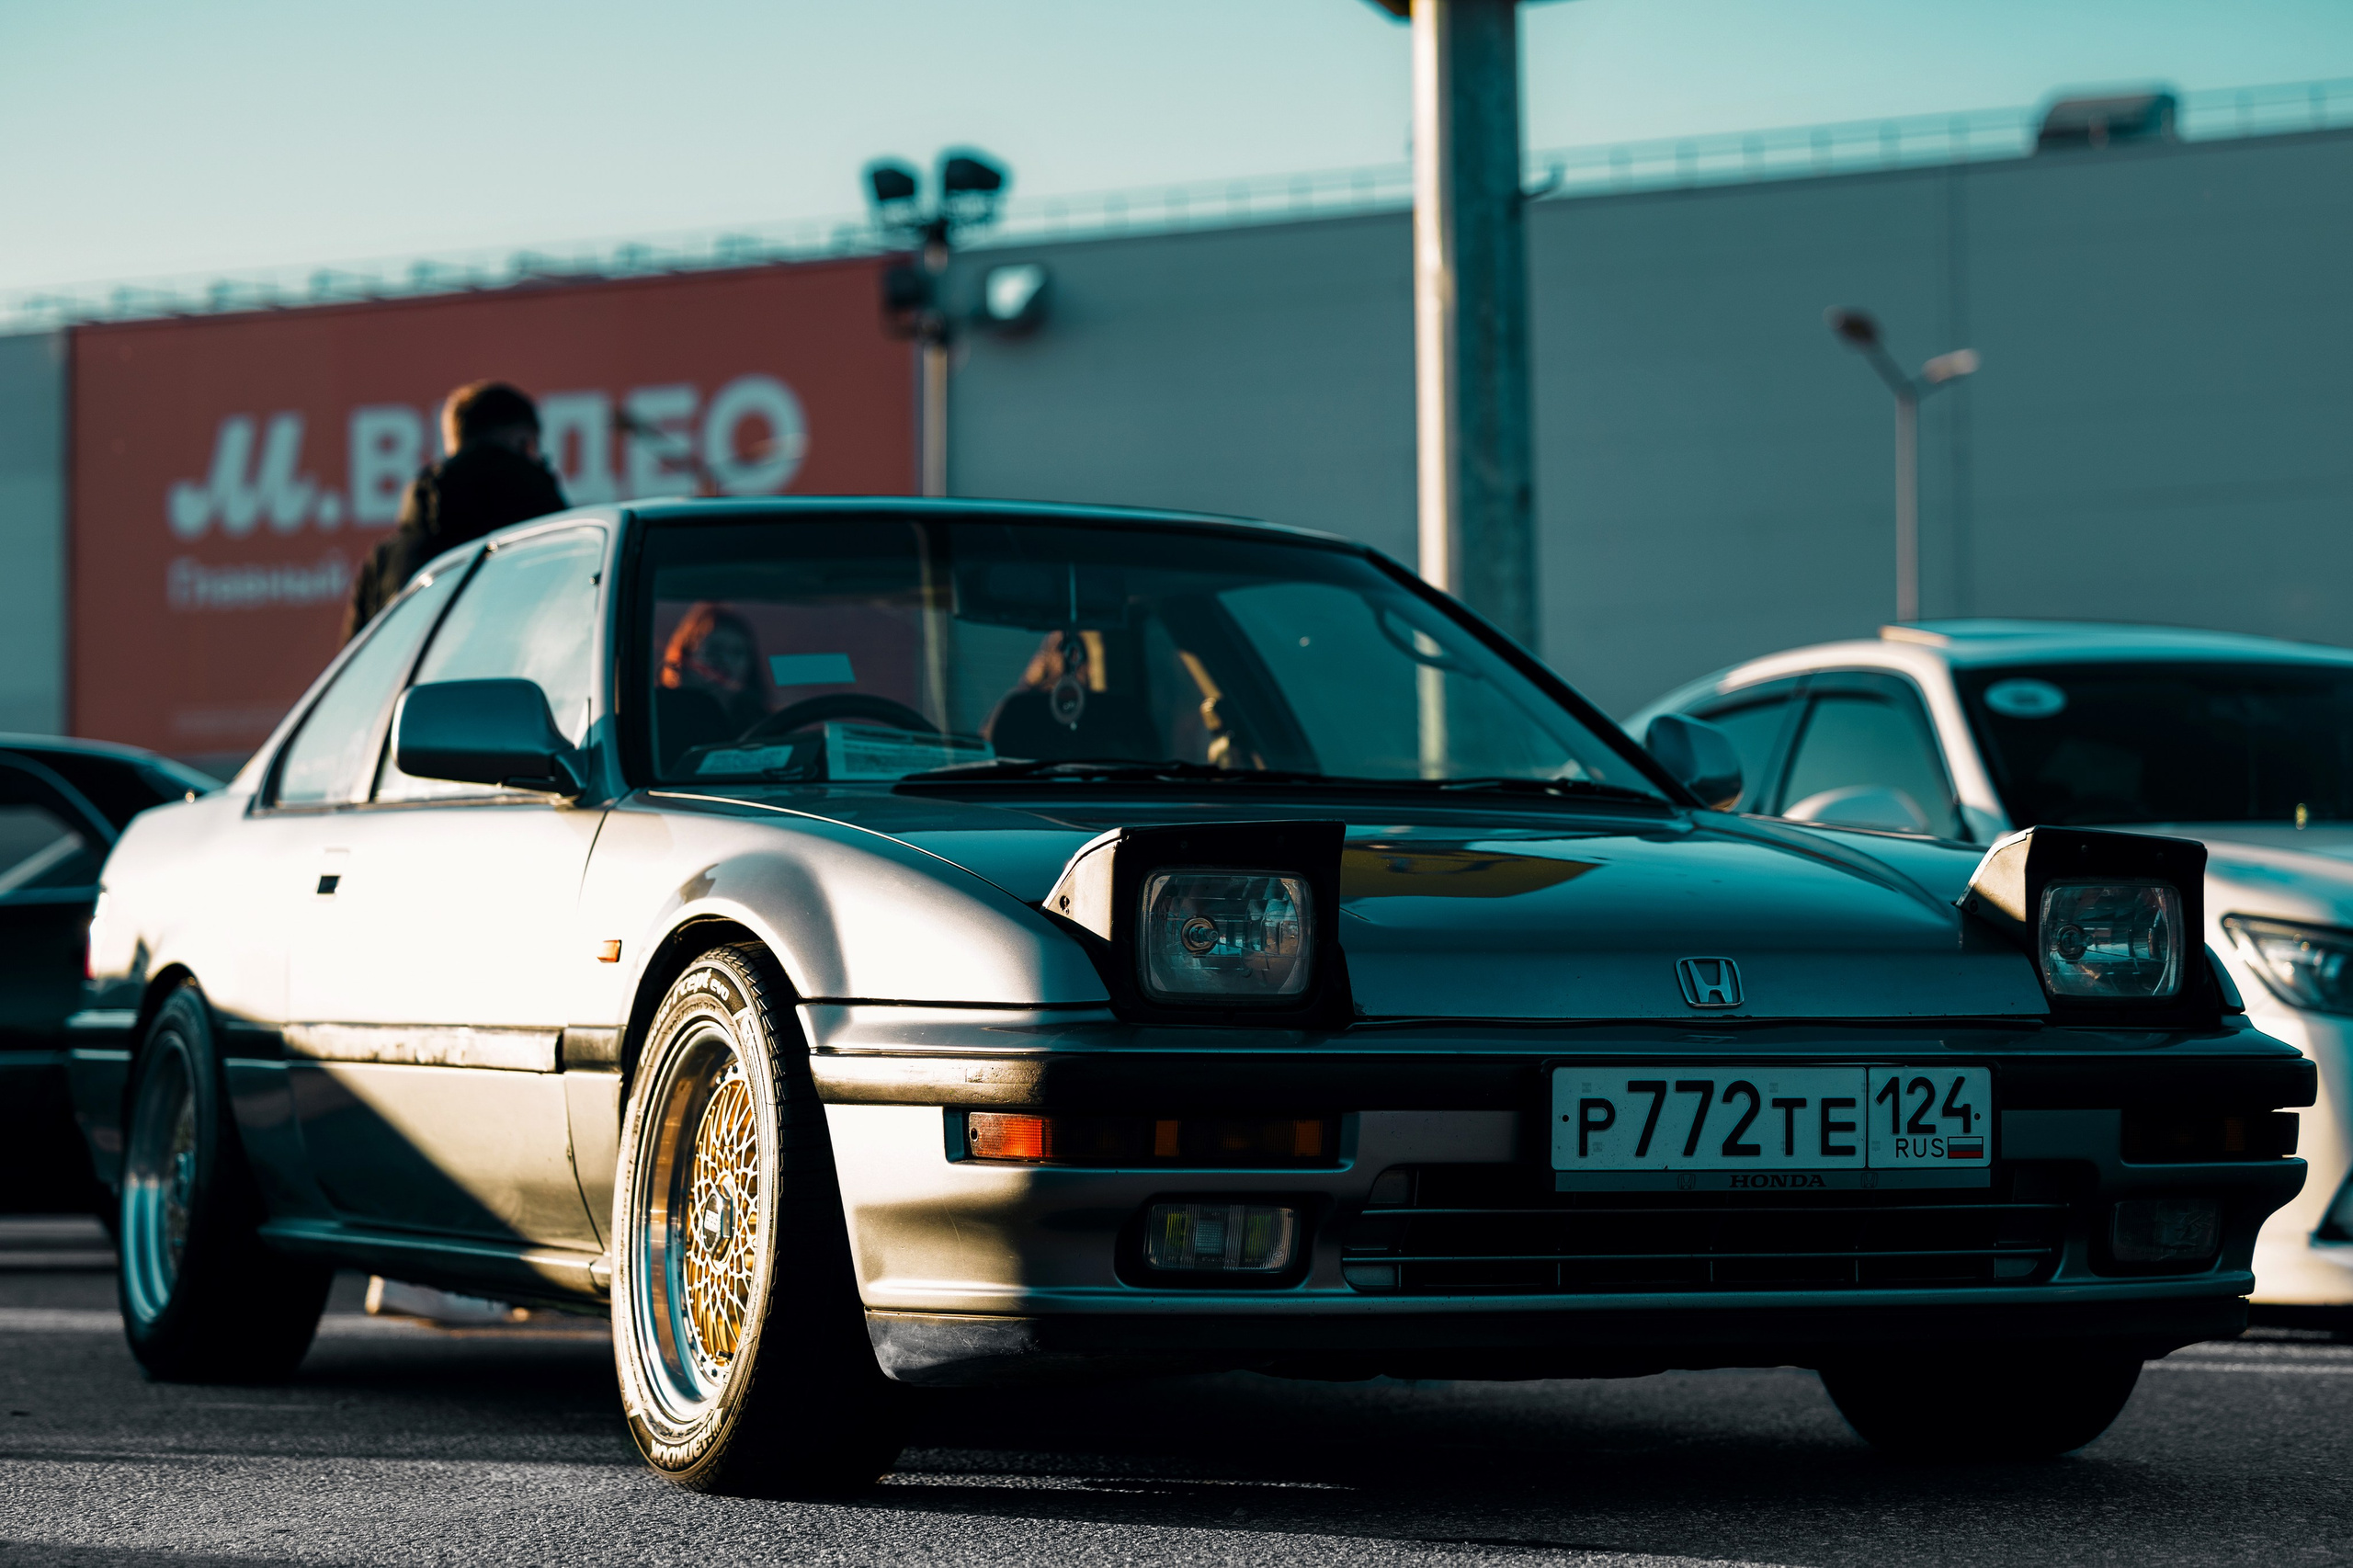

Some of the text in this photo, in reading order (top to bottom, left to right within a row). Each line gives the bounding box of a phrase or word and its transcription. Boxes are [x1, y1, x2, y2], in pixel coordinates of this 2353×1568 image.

[168, 372, 809, 540] М.ВДЕО
[710, 978, 730, 1001] evo
[1875, 1075, 1972, 1134] 124
[1895, 1136, 1946, 1159] RUS
[1728, 1173, 1826, 1189] HONDA
